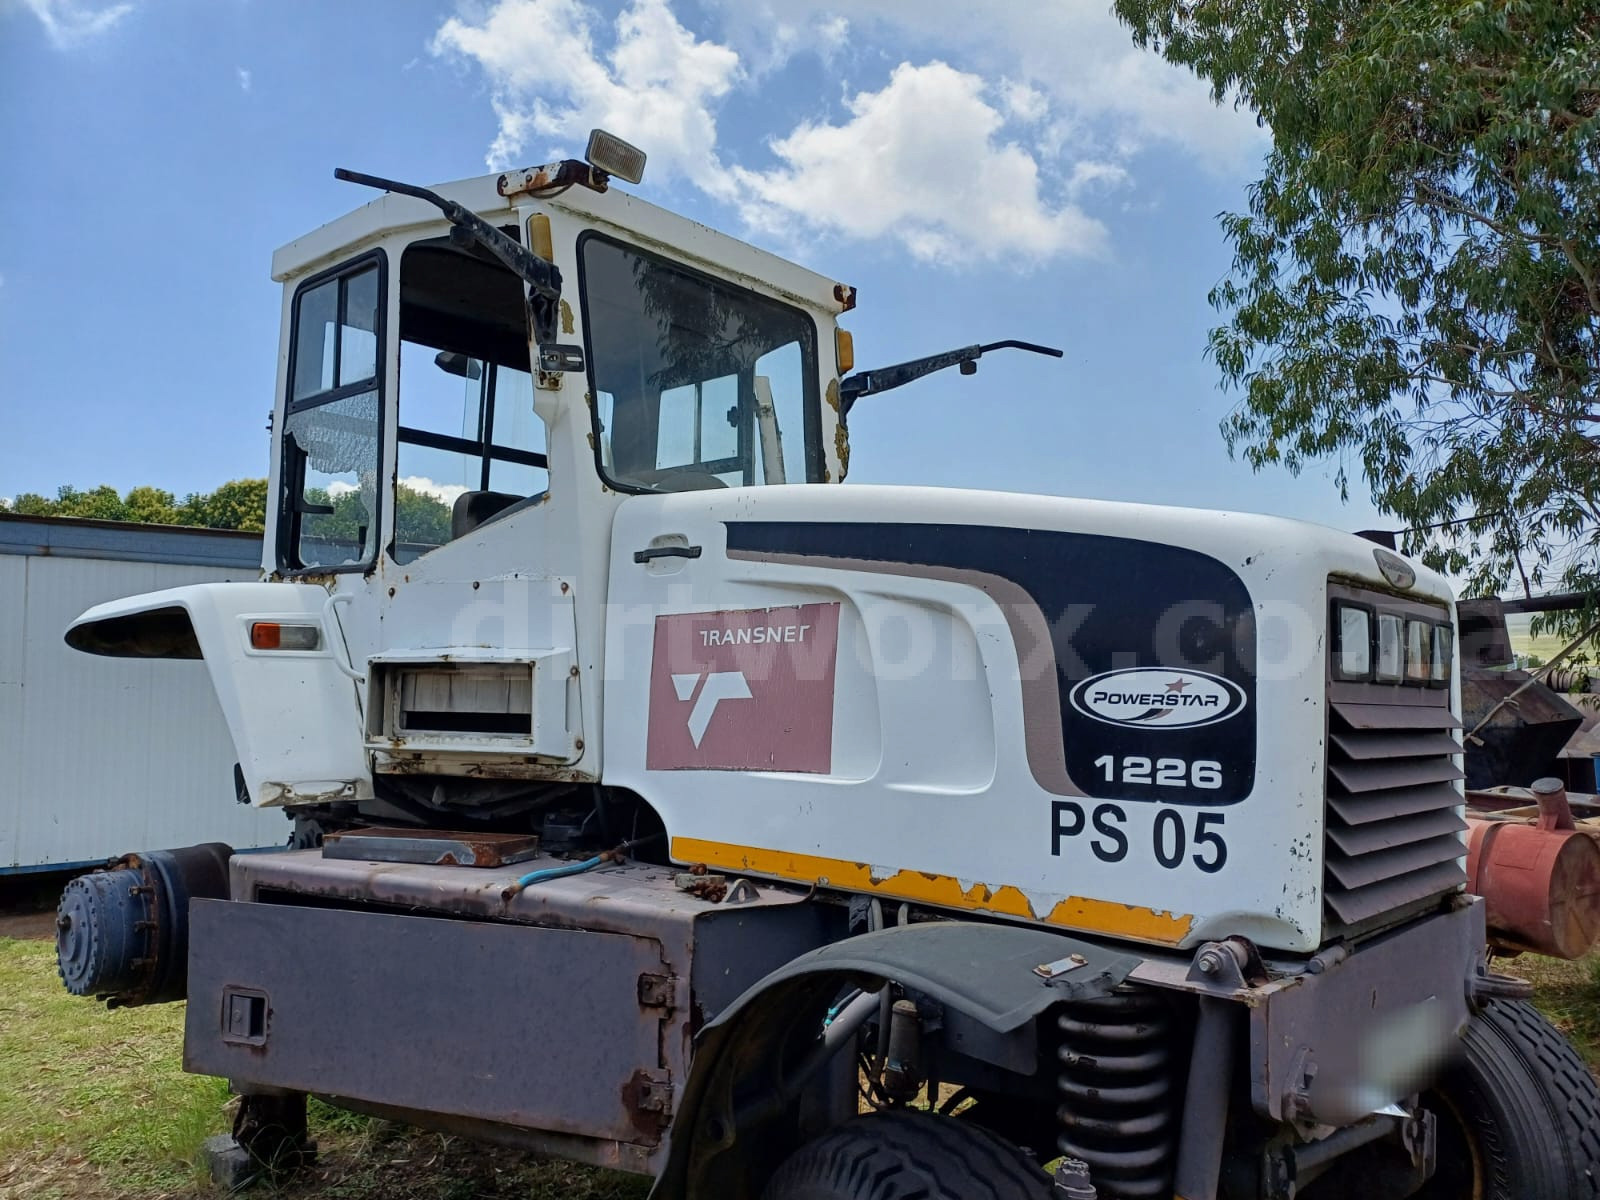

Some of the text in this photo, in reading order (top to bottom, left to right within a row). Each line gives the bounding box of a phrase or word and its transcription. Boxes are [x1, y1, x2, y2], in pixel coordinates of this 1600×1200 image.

[700, 625, 811, 646] TRANSNET
[1093, 691, 1219, 707] POWERSTAR
[1094, 754, 1223, 789] 1226
[1051, 800, 1228, 874] PS 05
